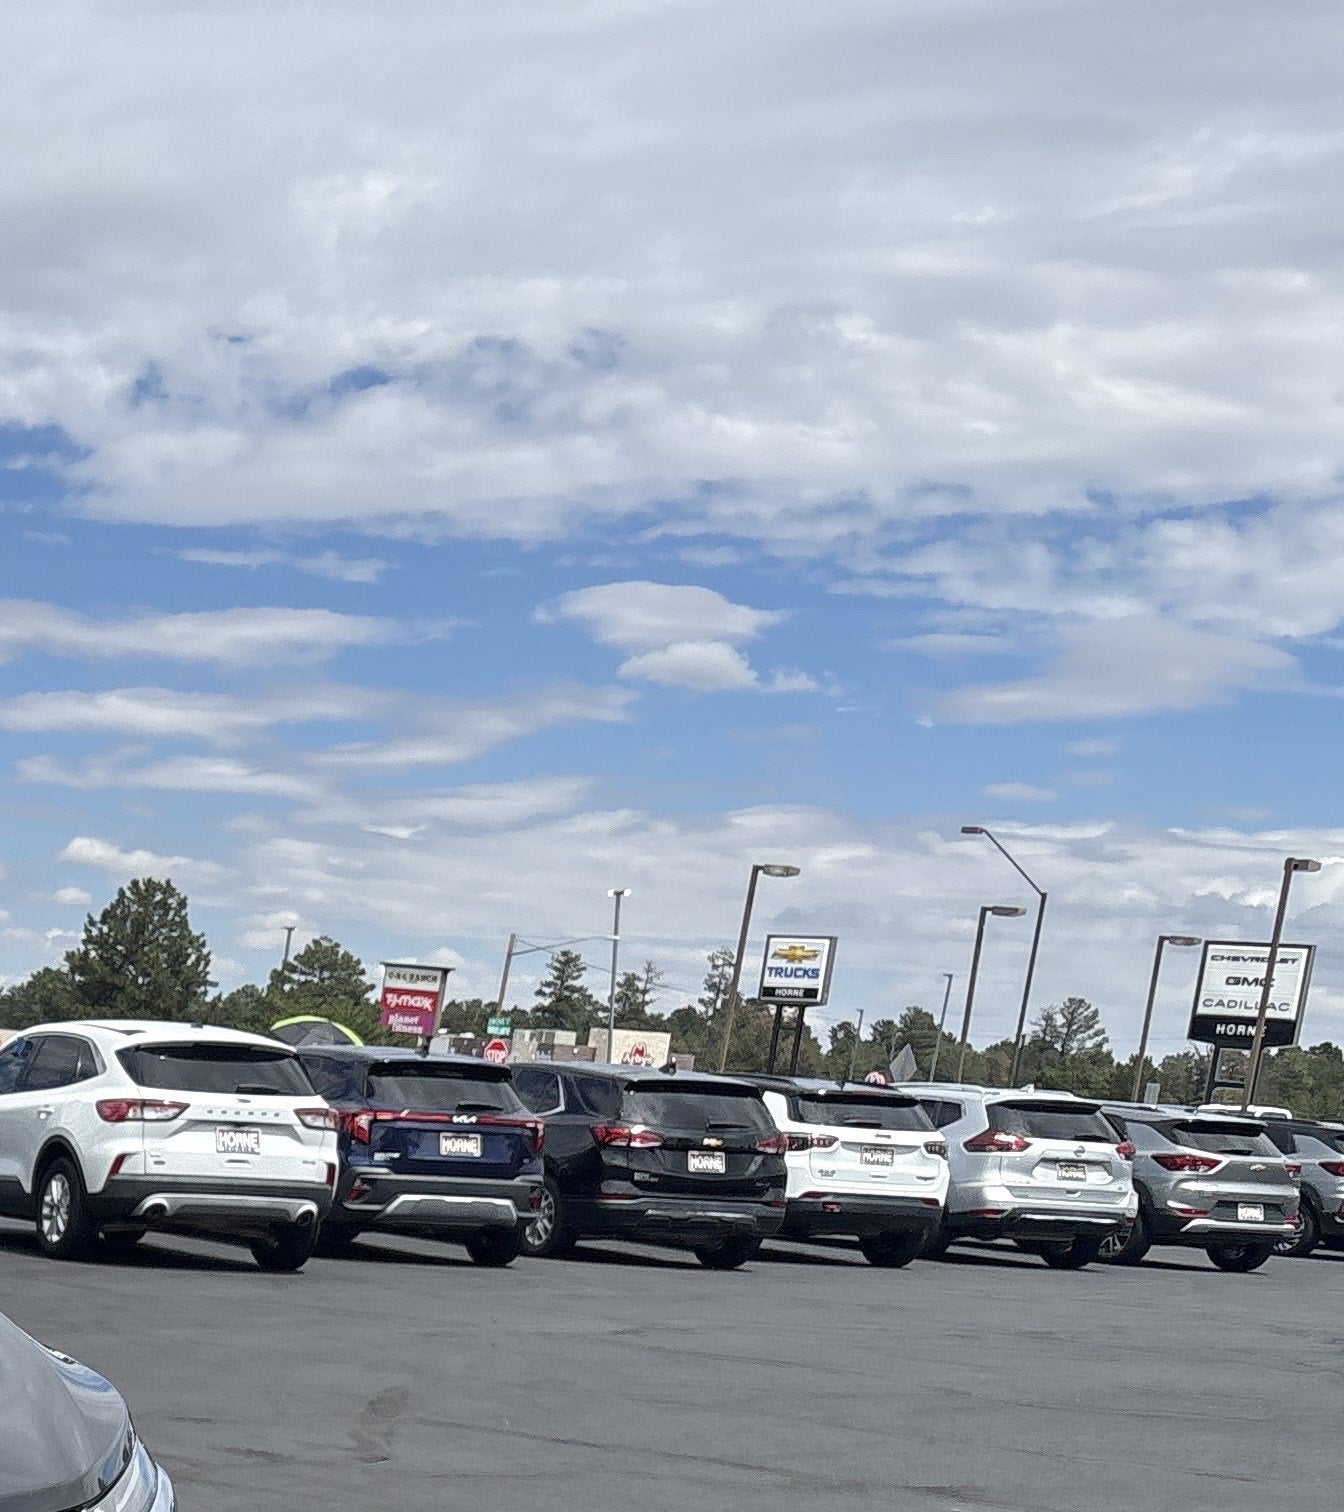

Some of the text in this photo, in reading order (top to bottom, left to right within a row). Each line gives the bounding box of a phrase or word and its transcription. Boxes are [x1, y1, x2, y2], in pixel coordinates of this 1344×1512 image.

[767, 966, 821, 979] TRUCKS
[774, 988, 805, 998] HORNE
[218, 1131, 259, 1150] HORNE
[442, 1137, 478, 1153] HORNE
